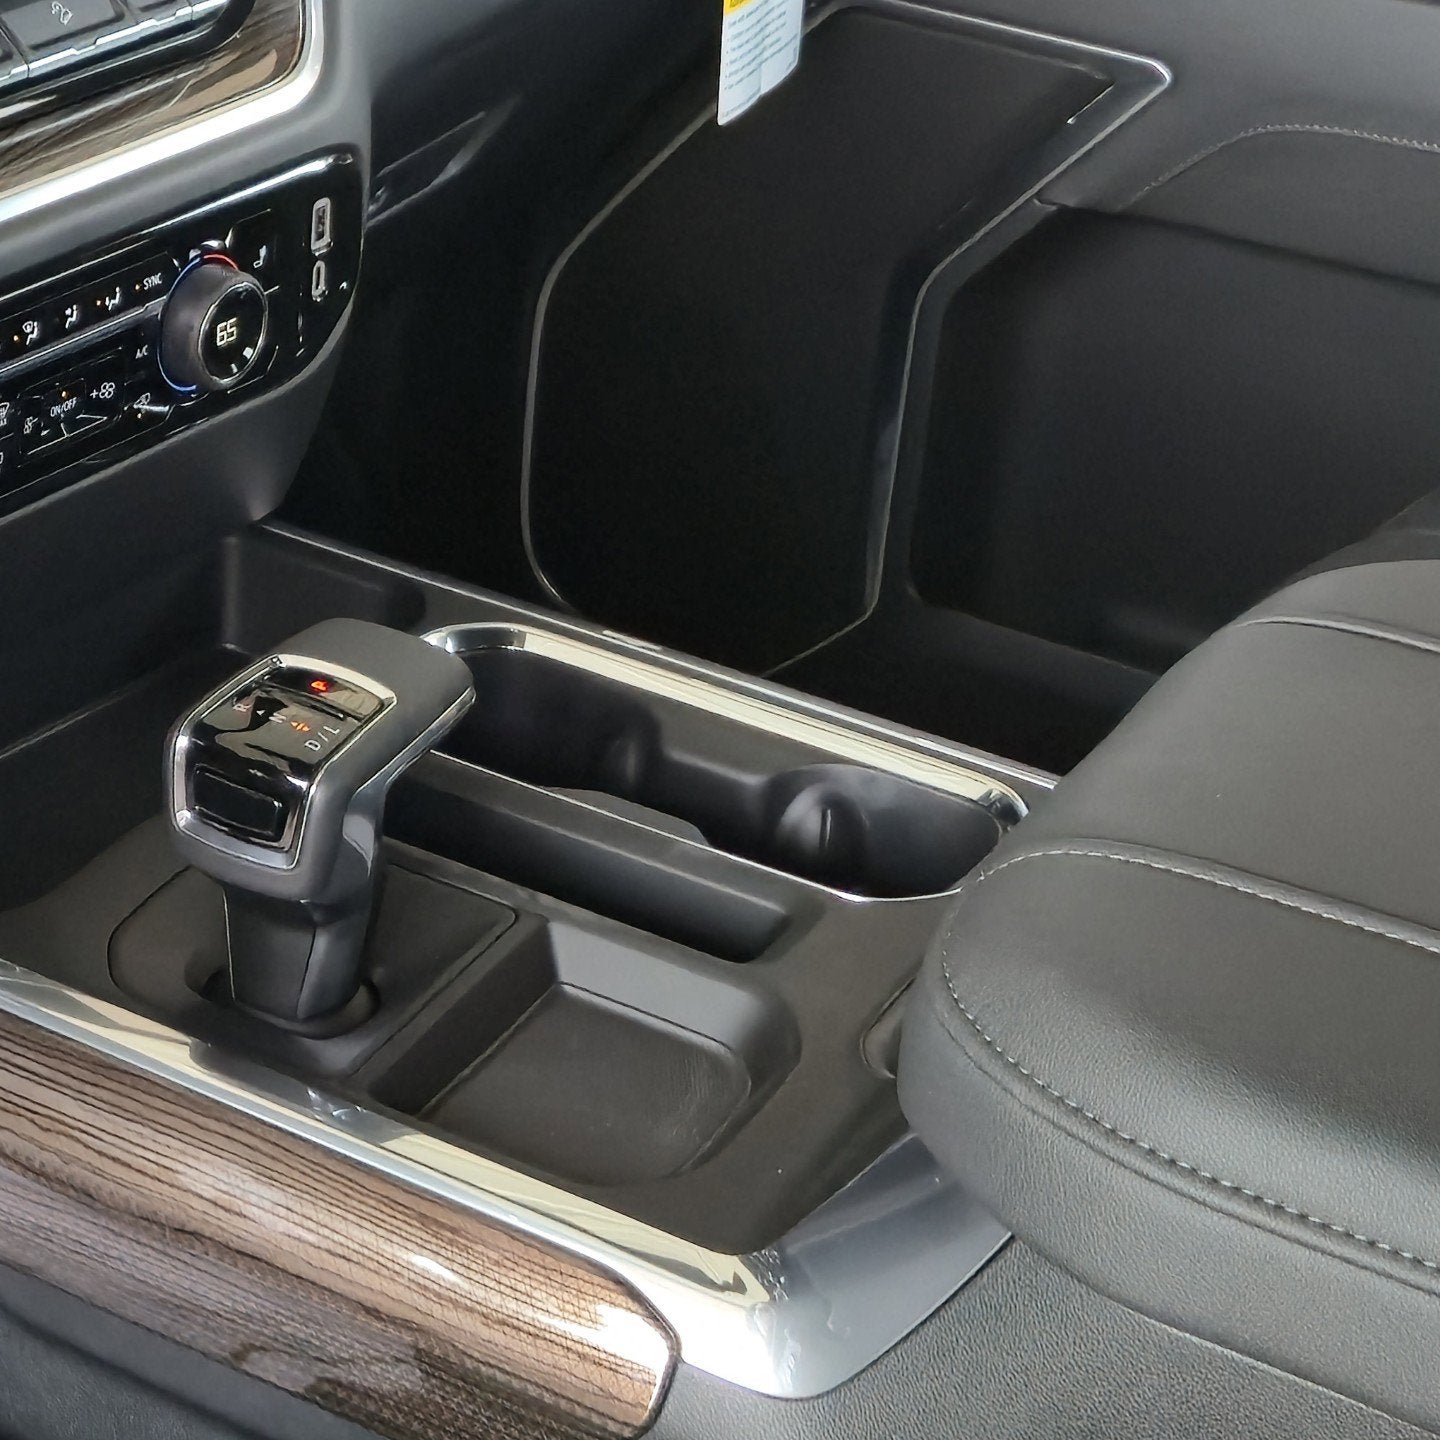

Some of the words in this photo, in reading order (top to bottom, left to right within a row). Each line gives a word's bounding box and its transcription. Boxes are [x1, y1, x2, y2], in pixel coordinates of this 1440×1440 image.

[142, 272, 163, 291] SYNC
[215, 318, 239, 347] 65
[134, 344, 149, 359] A/C
[50, 397, 78, 418] ON/OFF
